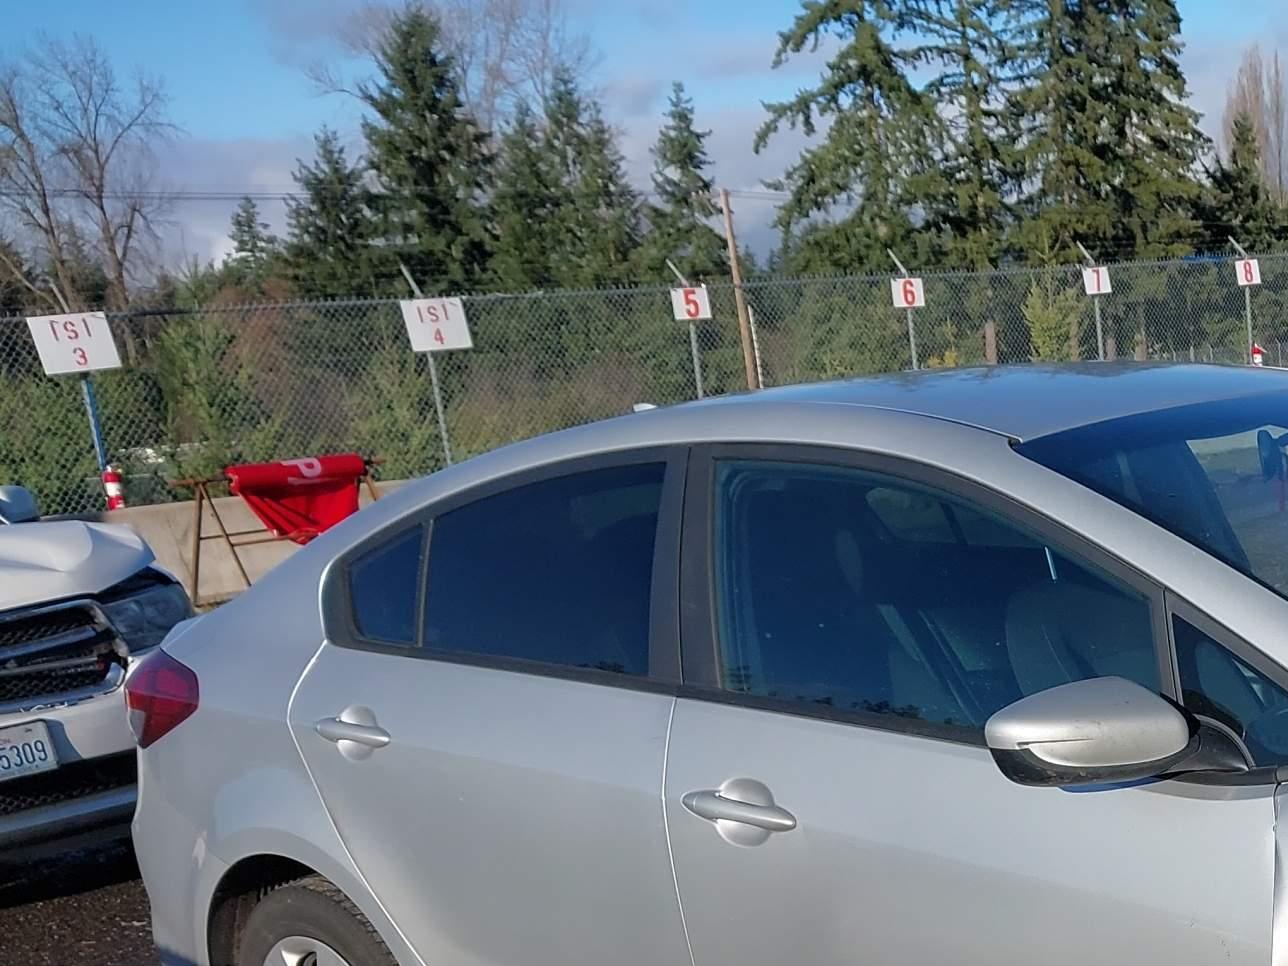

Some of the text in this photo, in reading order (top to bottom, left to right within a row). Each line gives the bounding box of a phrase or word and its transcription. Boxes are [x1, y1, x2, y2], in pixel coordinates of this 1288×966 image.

[1091, 269, 1101, 292] 7
[1244, 261, 1254, 283] 8
[683, 288, 699, 318] 5
[903, 279, 916, 306] 6
[434, 327, 445, 345] 4
[73, 346, 88, 366] 3
